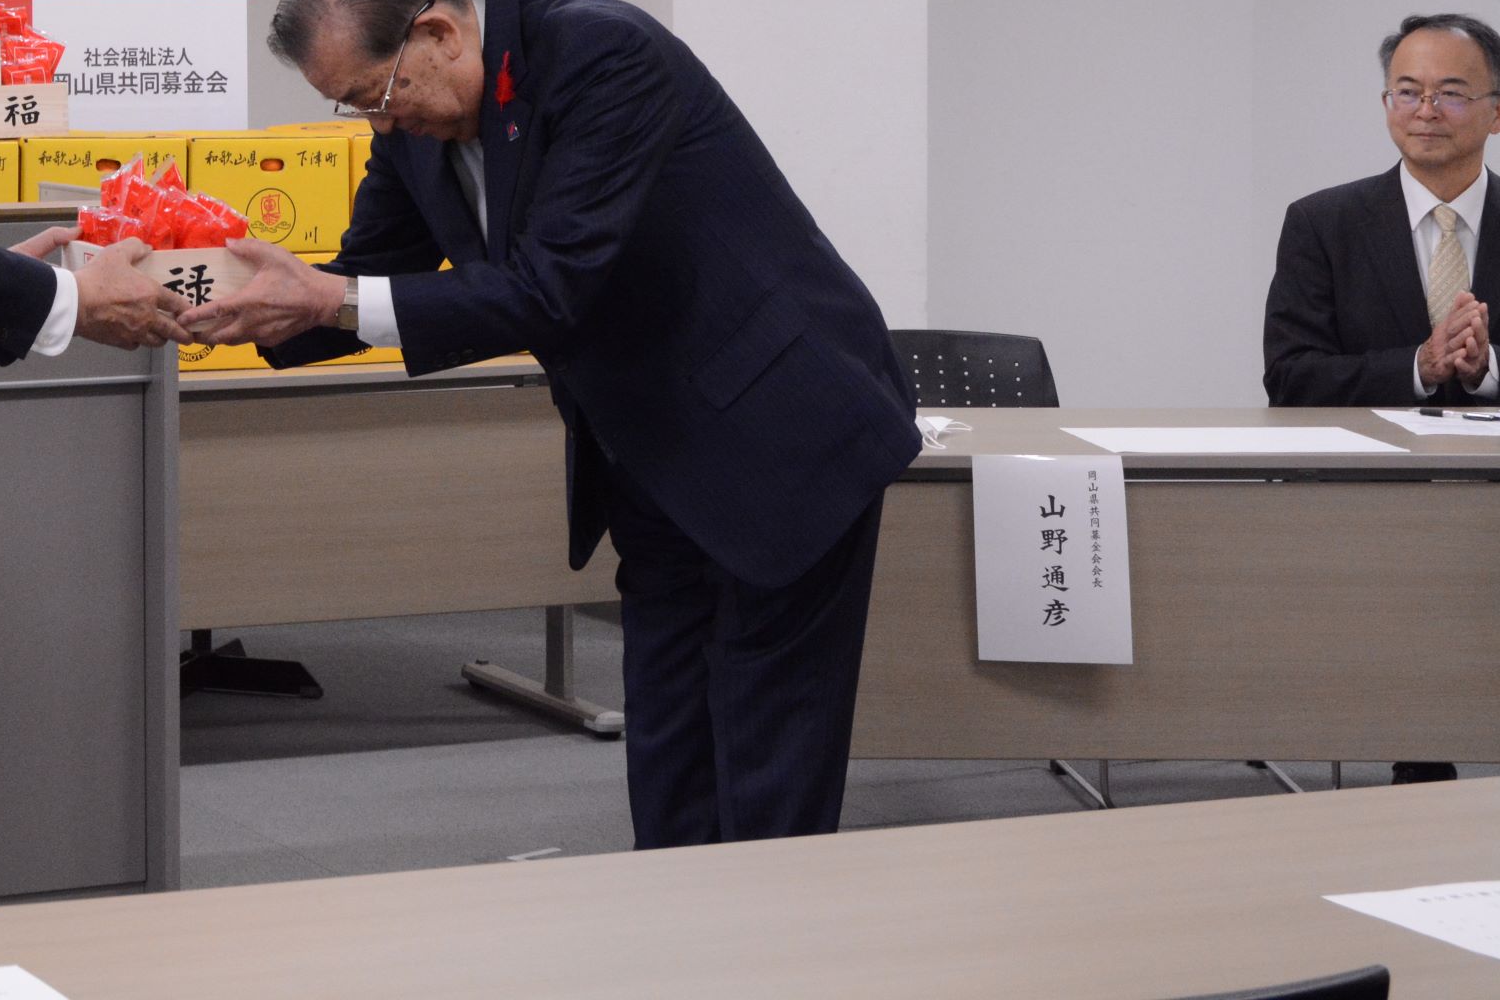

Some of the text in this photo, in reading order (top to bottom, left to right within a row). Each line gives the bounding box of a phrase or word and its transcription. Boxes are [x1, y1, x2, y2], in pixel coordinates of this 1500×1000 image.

[83, 47, 194, 68] 社会福祉法人
[4, 95, 41, 127] 福
[38, 150, 93, 168] 和歌山県
[204, 150, 339, 168] 和歌山県 下津町
[1088, 470, 1103, 588] 岡山県共同募金会会長
[1039, 494, 1070, 627] 山野通彦
